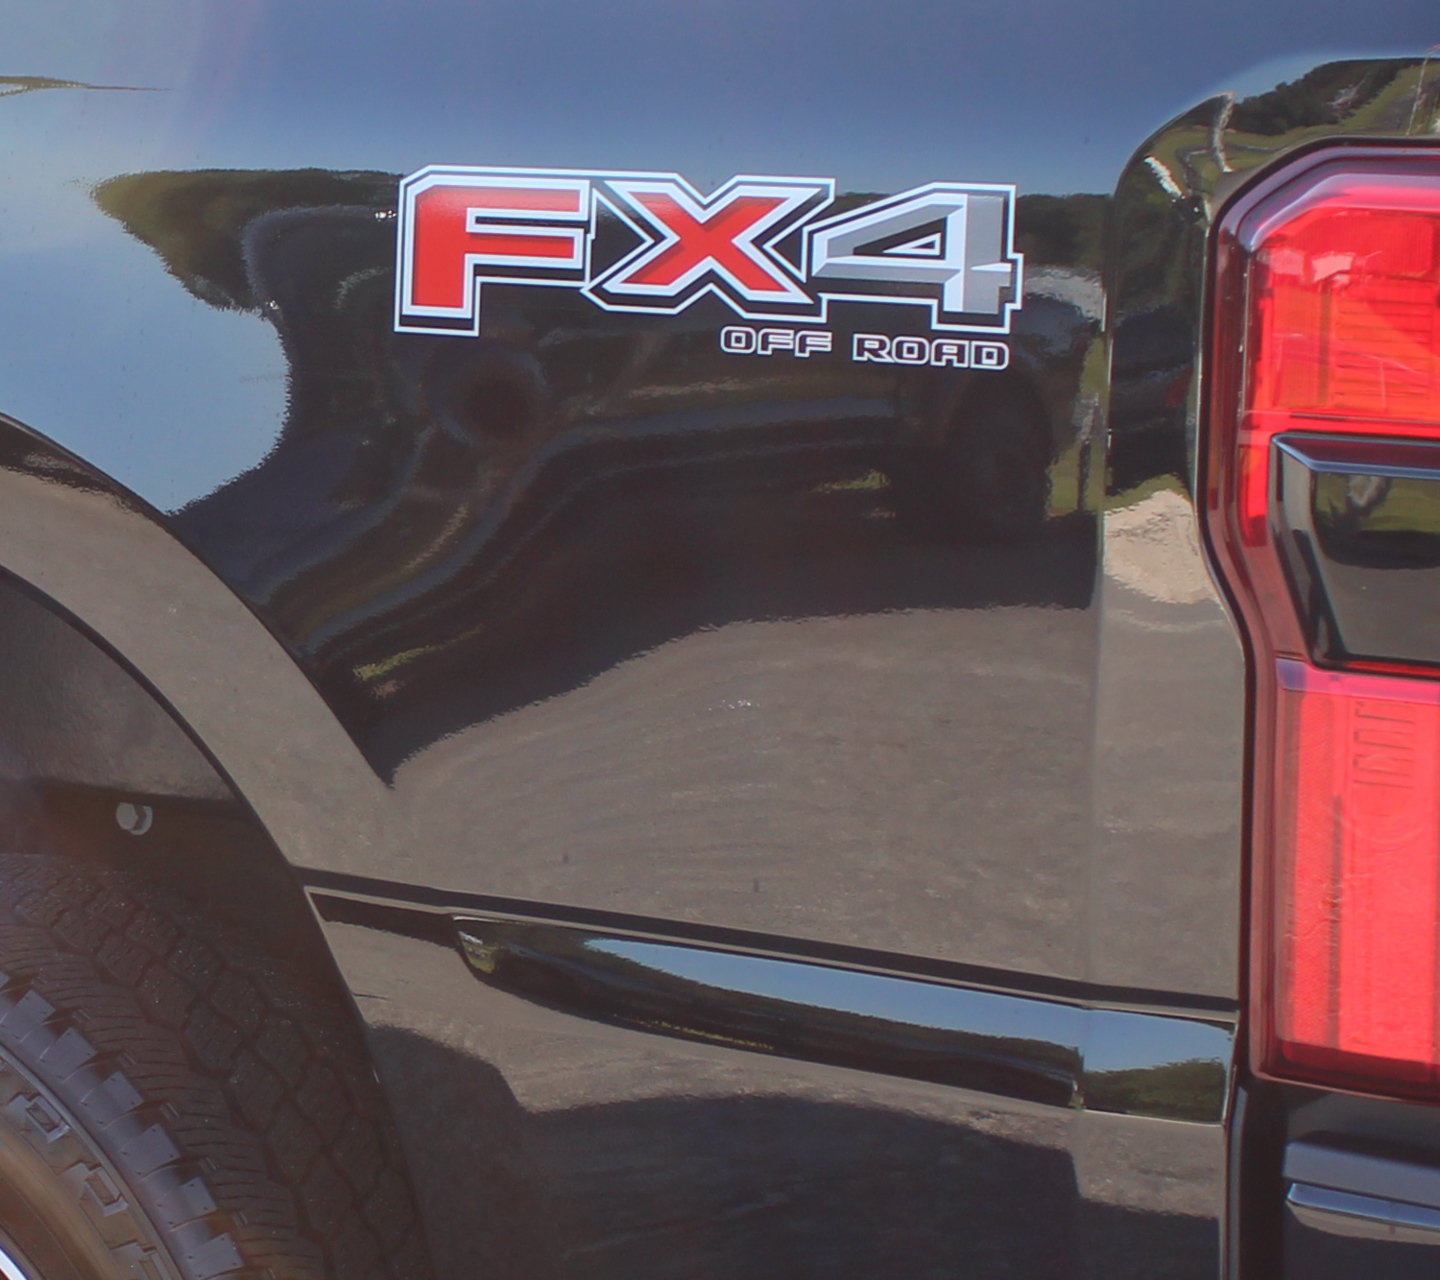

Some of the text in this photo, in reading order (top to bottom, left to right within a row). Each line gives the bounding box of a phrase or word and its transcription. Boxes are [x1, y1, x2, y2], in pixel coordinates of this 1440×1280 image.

[394, 164, 1024, 337] FX4
[720, 325, 1011, 372] OFF ROAD
